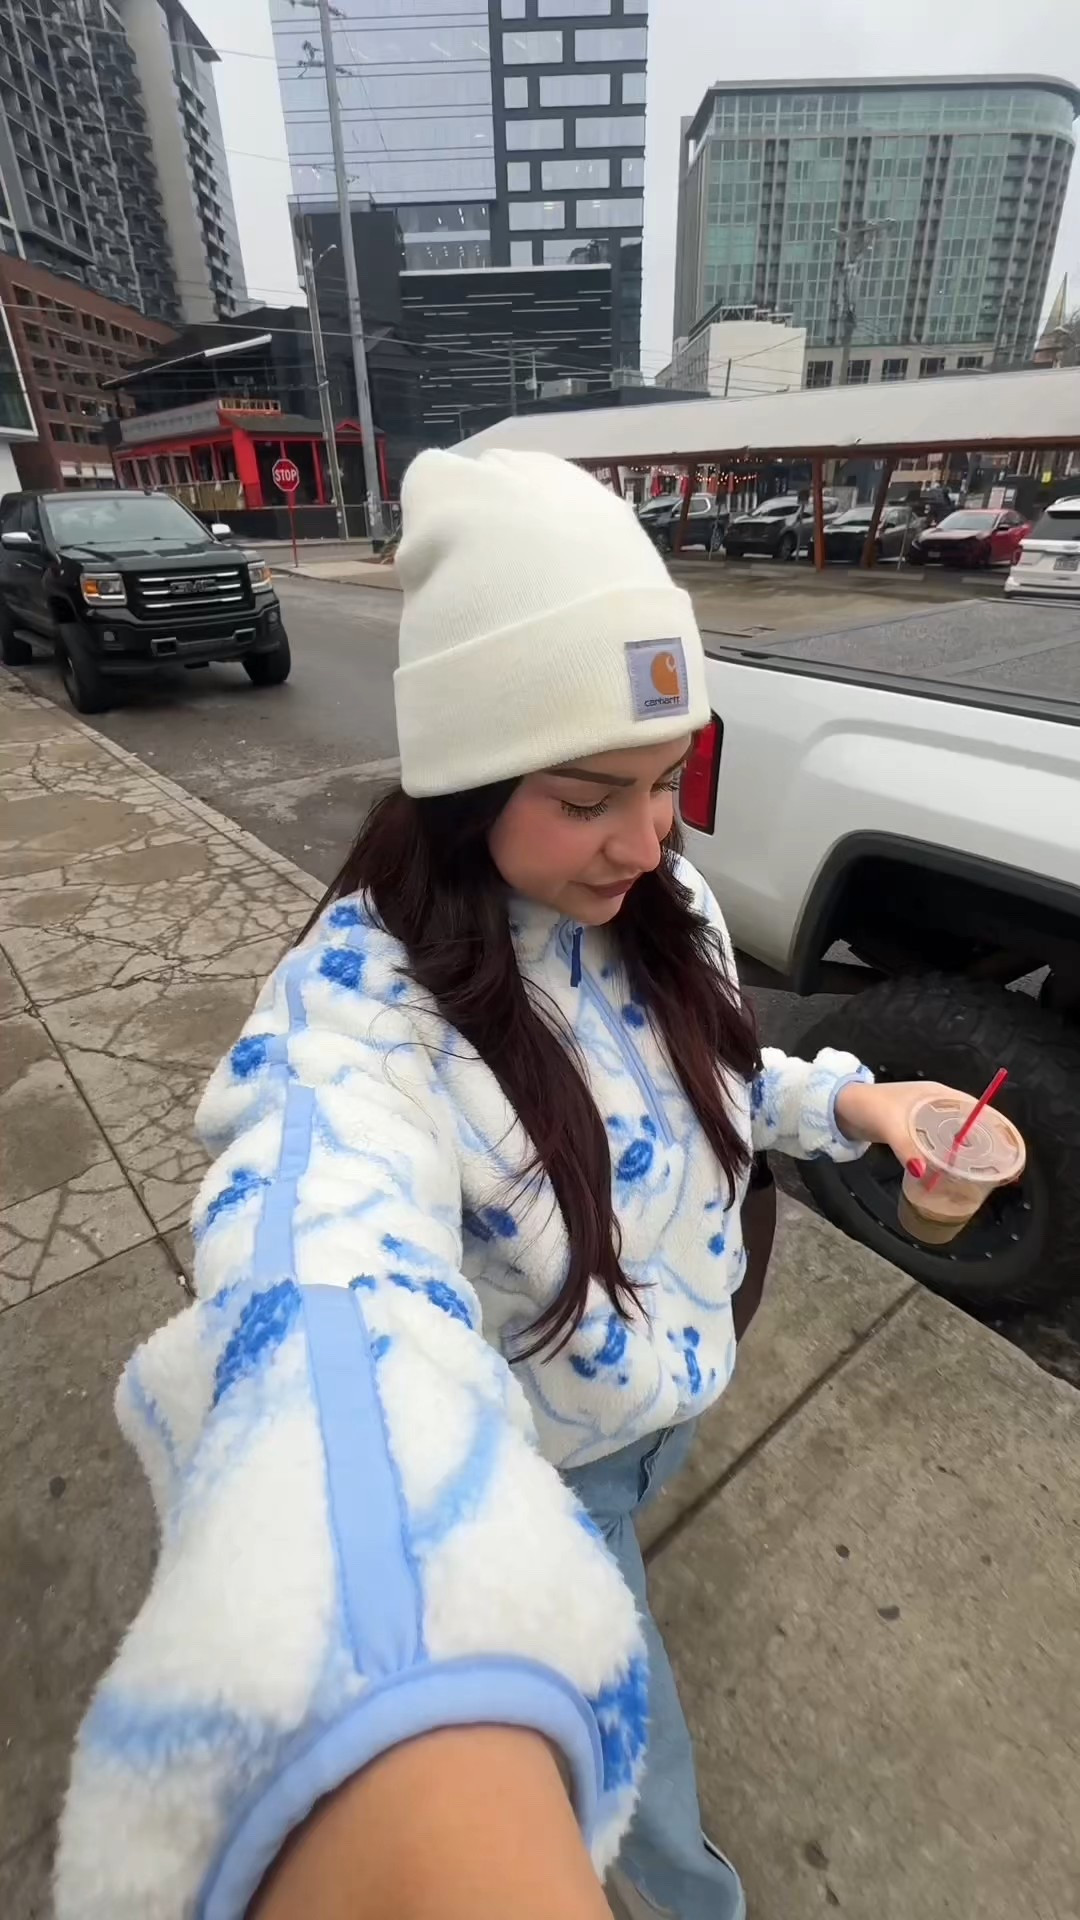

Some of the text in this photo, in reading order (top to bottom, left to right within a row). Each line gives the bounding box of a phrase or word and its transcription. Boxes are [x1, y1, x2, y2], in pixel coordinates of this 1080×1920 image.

[275, 470, 296, 482] STOP
[170, 579, 216, 593] GMC
[644, 696, 680, 707] carhartt
